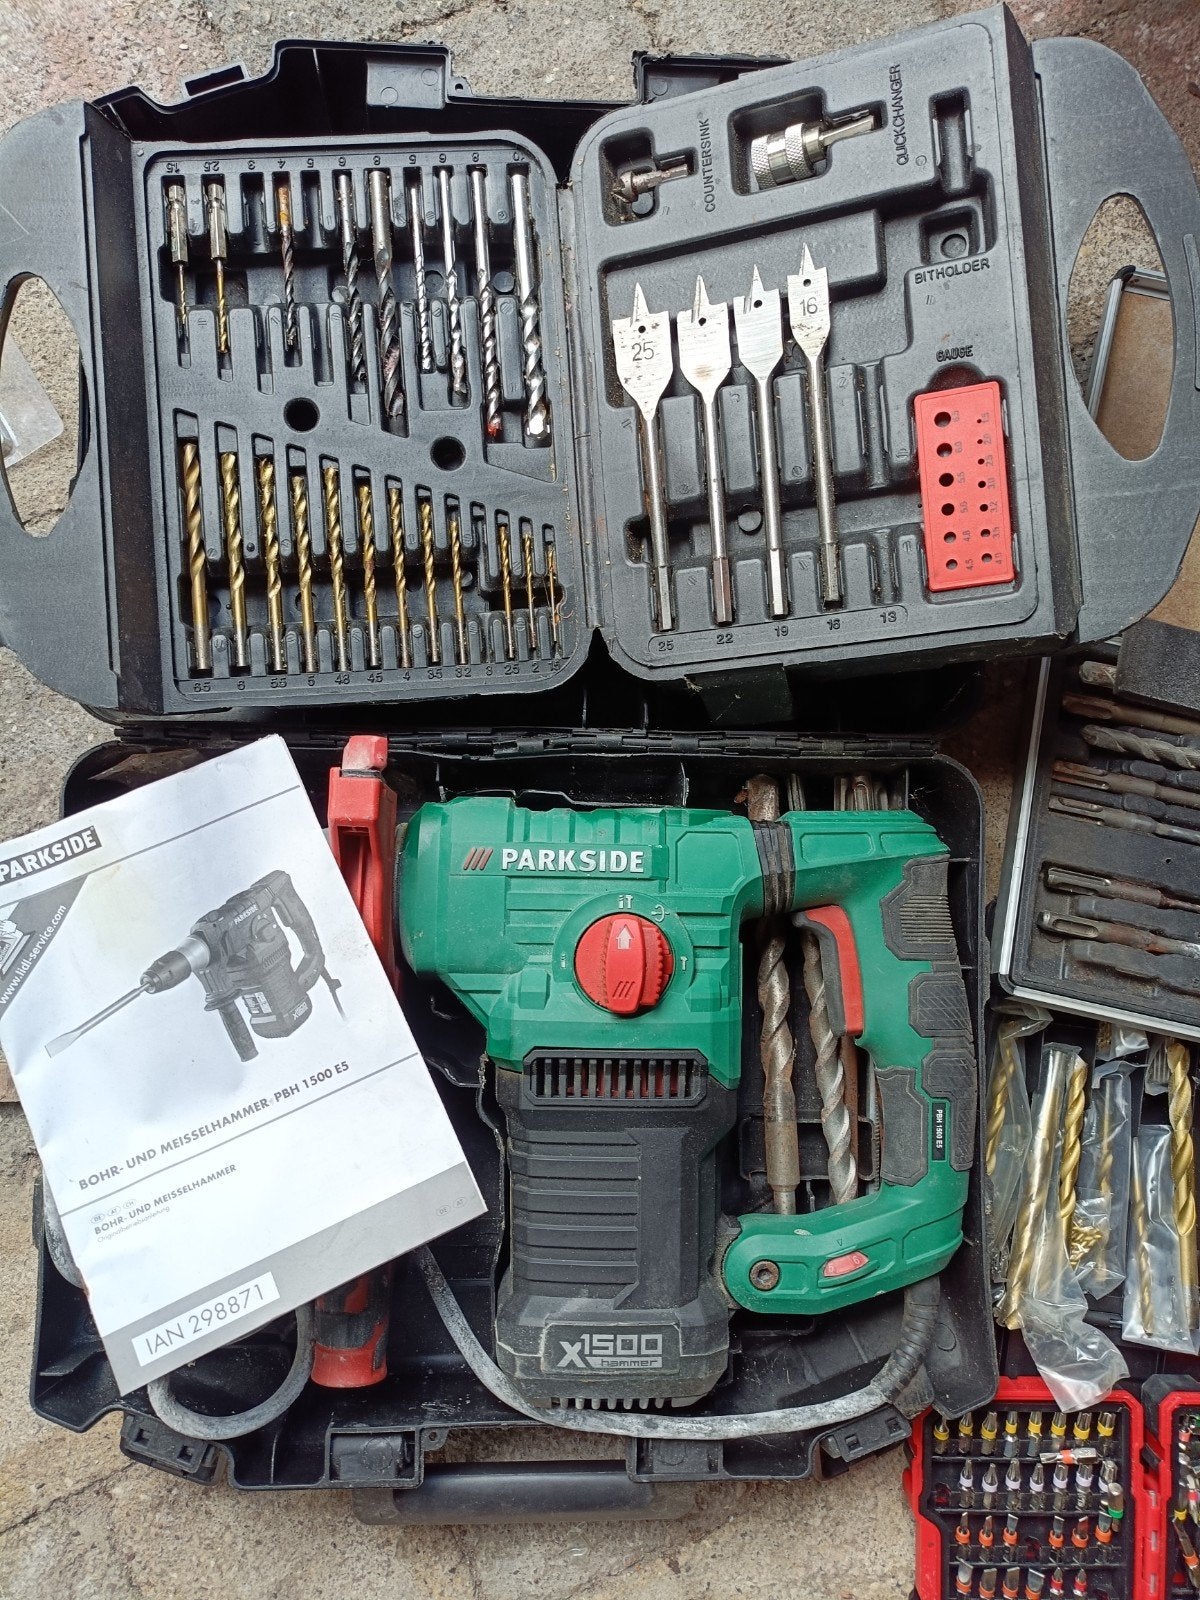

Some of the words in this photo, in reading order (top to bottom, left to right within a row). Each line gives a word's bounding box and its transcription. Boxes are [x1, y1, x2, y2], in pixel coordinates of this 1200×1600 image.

[889, 64, 909, 165] QUICKCHANGER
[247, 160, 256, 170] 3
[277, 159, 286, 169] 4
[307, 158, 314, 168] 5
[409, 154, 416, 164] 5
[699, 118, 716, 213] COUNTERSINK
[914, 258, 990, 284] BITHOLDER
[800, 297, 818, 316] 16
[631, 341, 654, 361] 25
[658, 640, 674, 652] 25
[716, 633, 733, 644] 22
[775, 625, 789, 637] 19
[827, 619, 840, 630] 16
[880, 612, 897, 623] 13
[237, 681, 246, 691] 6
[307, 677, 315, 686] 5
[402, 670, 411, 681] 4
[485, 665, 493, 676] 3
[532, 662, 539, 672] 2
[0, 830, 96, 882] PARKSIDE
[501, 848, 644, 873] PARKSIDE
[0, 904, 66, 1004] www.lidl-service.com
[78, 1164, 124, 1190] BOHR-
[126, 1148, 157, 1169] UND
[160, 1098, 269, 1154] MEISSELHAMMER
[273, 1083, 300, 1102] PBH
[302, 1068, 333, 1089] 1500
[334, 1061, 349, 1074] E5
[94, 1216, 127, 1234] BOHR-
[129, 1203, 151, 1219] UND
[154, 1164, 237, 1206] MEISSELHAMMER
[853, 1255, 860, 1265] 6
[145, 1323, 185, 1355] IAN
[188, 1284, 264, 1334] 298871
[600, 1358, 658, 1368] hammer
